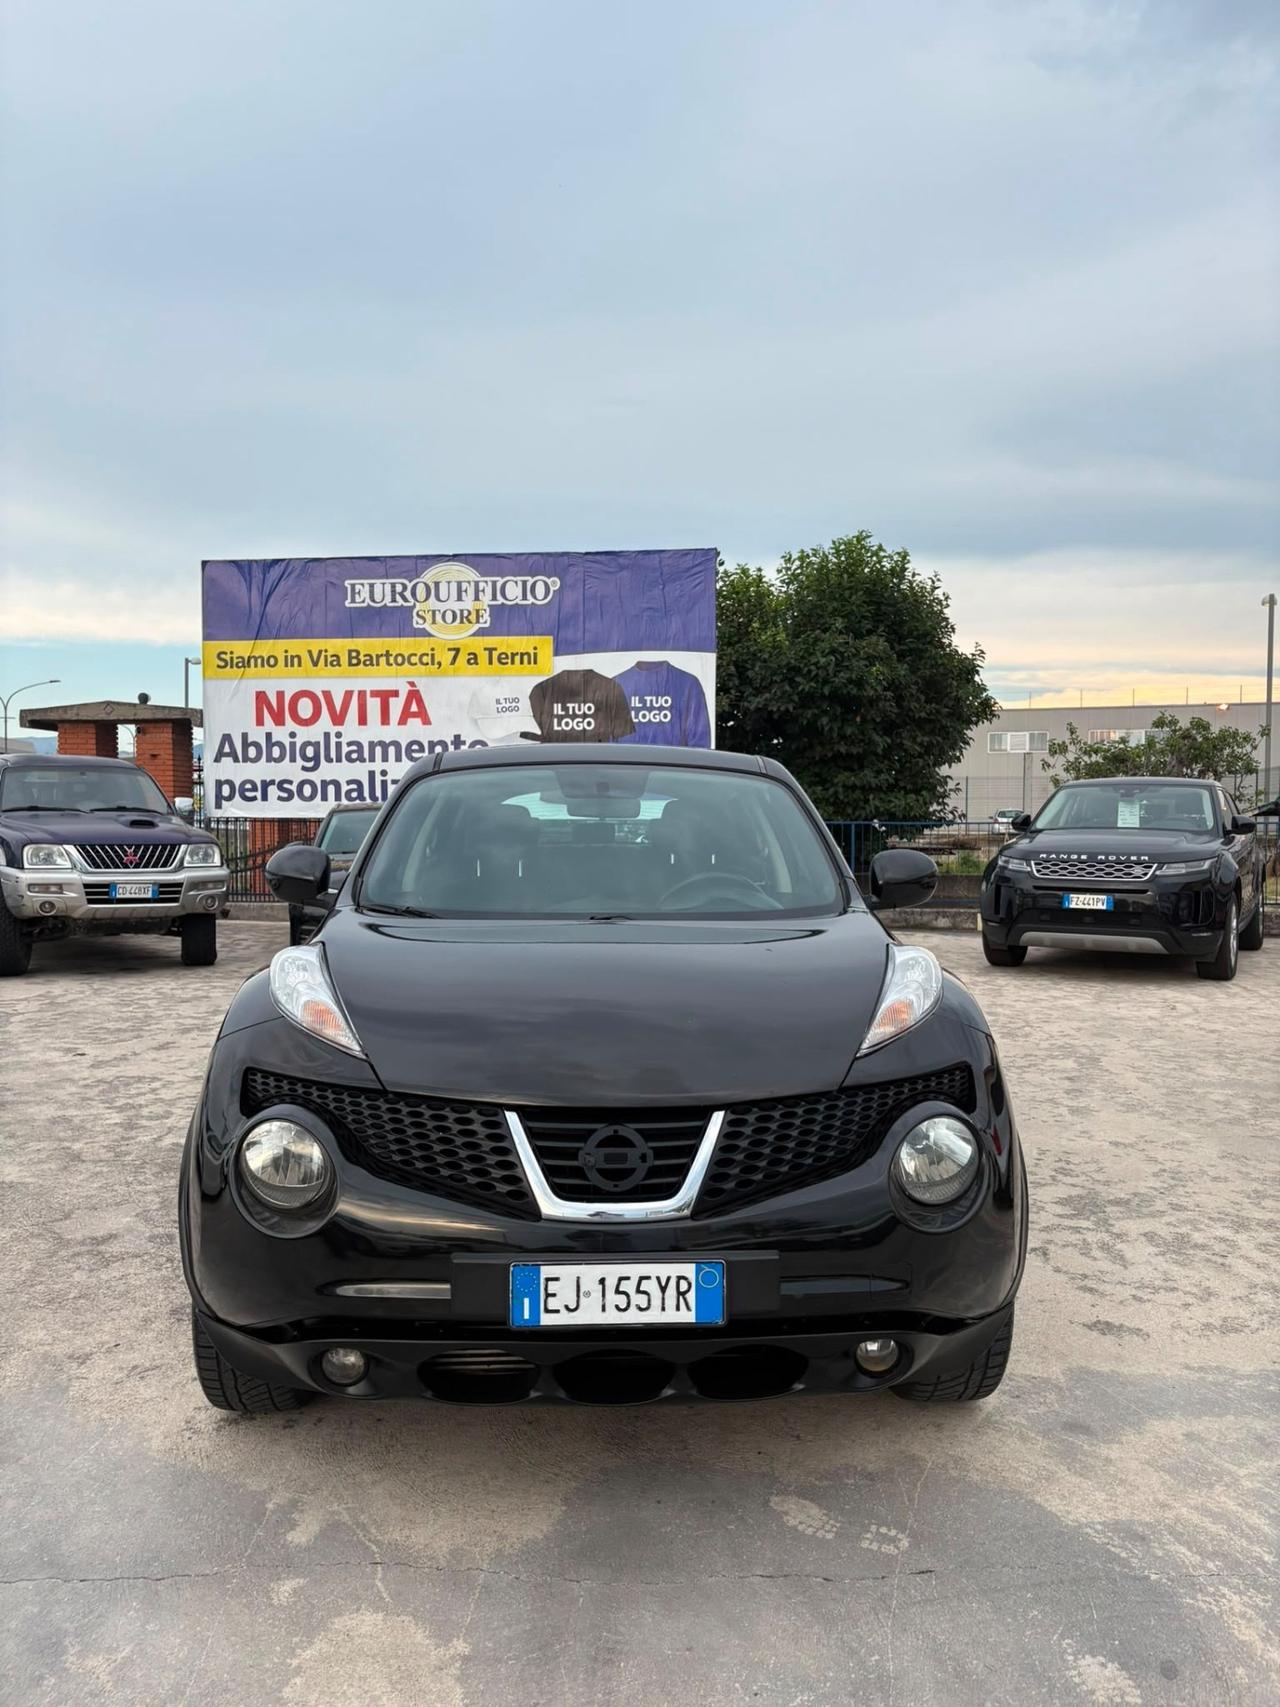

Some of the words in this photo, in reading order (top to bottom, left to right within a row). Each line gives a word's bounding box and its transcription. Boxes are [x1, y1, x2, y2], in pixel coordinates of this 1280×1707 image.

[415, 608, 488, 625] STORE
[216, 651, 279, 669] Siamo
[284, 650, 302, 668] in
[307, 649, 341, 668] Via
[347, 647, 442, 670] Bartocci,
[447, 647, 461, 666] 7
[466, 652, 479, 666] a
[483, 646, 538, 666] Terni
[255, 681, 432, 727] NOVITÀ
[504, 697, 520, 705] TUO
[631, 696, 643, 708] IL
[644, 695, 672, 708] TUO
[496, 705, 520, 713] LOGO
[553, 703, 564, 715] IL
[566, 702, 595, 715] TUO
[631, 710, 672, 723] LOGO
[553, 718, 595, 731] LOGO
[214, 769, 400, 810] personali
